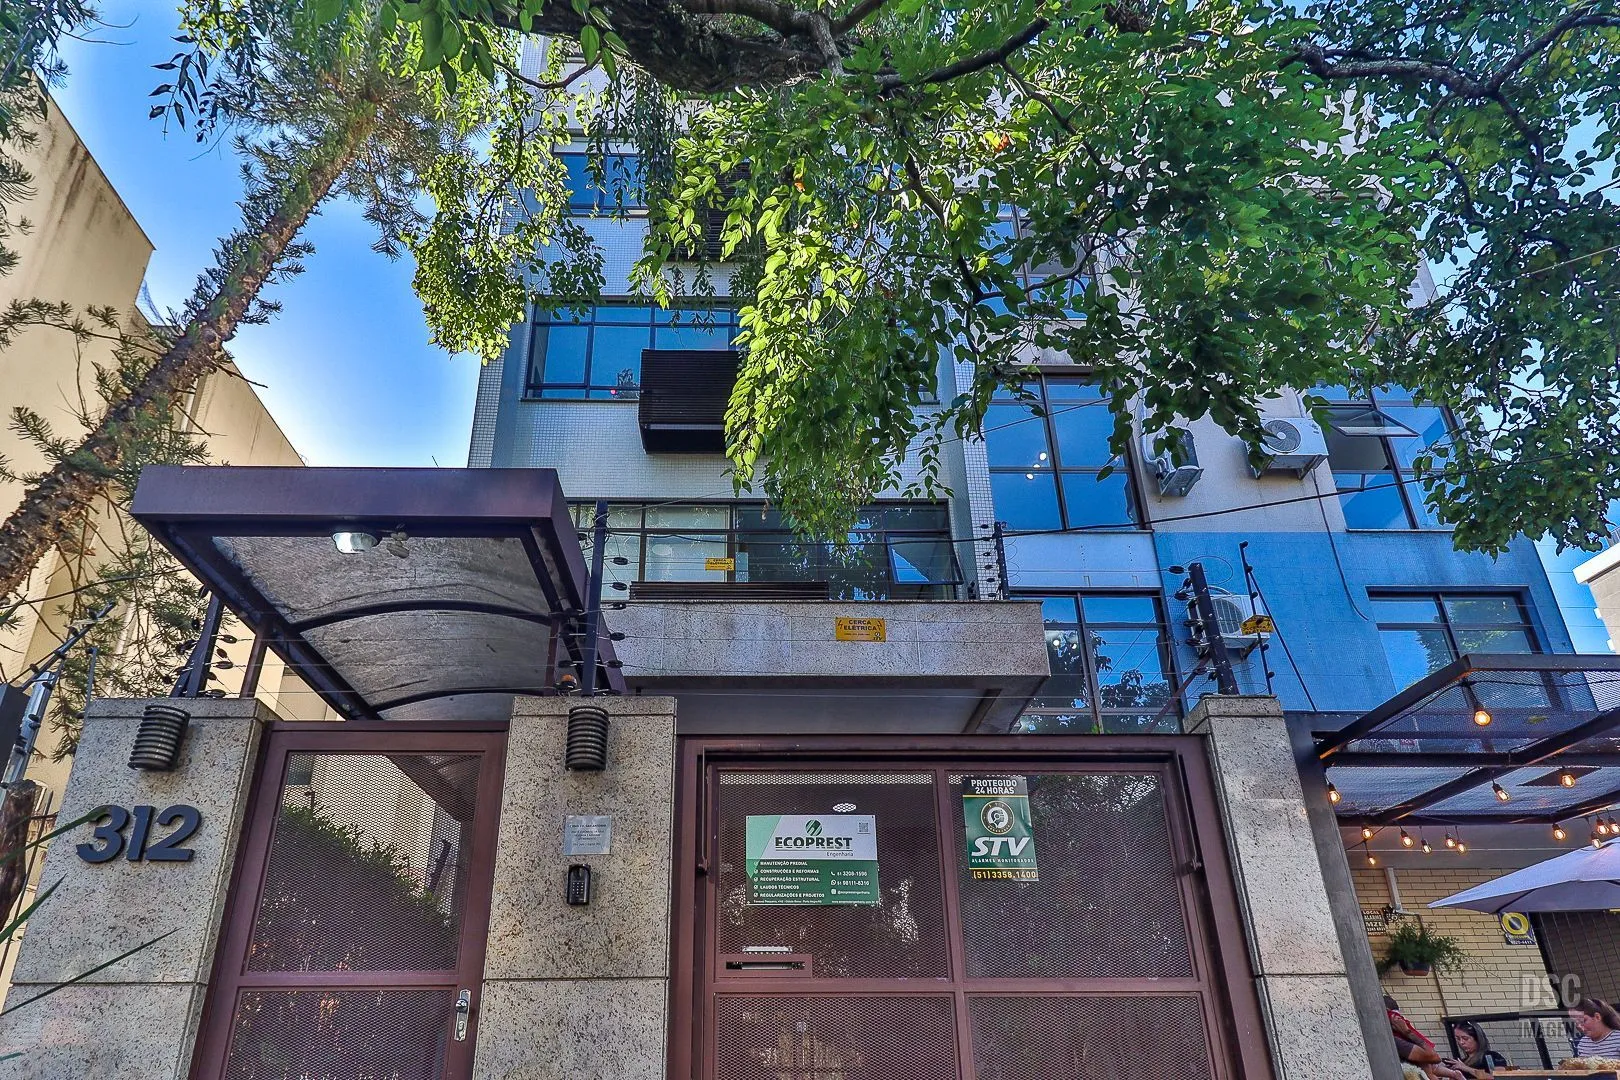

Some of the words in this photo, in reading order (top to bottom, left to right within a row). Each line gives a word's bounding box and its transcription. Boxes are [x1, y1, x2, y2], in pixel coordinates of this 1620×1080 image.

[971, 779, 1017, 787] PROTEGIDO
[987, 786, 1015, 794] HORAS
[76, 804, 201, 863] 312
[775, 837, 853, 849] ECOPREST
[971, 837, 1031, 856] STV
